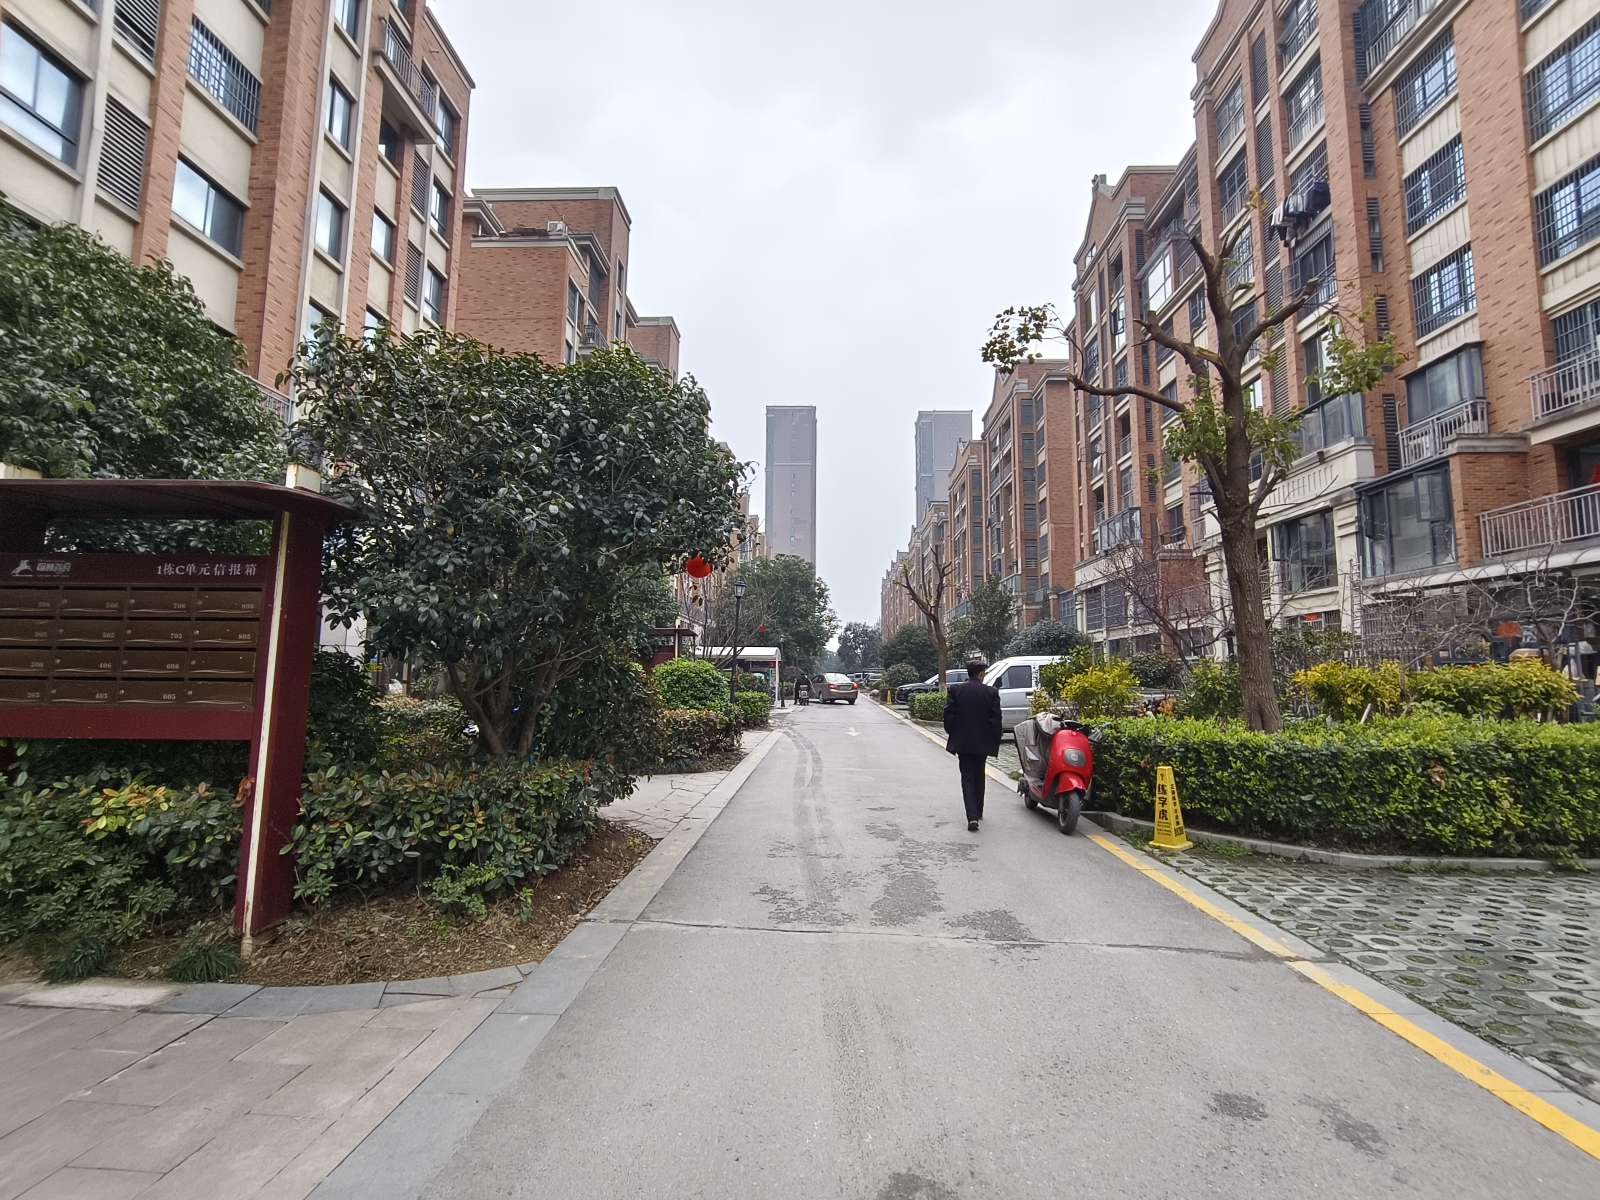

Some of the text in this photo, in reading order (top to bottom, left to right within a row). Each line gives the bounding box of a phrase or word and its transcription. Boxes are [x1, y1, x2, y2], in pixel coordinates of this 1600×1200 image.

[156, 562, 257, 577] 1栋C单元信报箱
